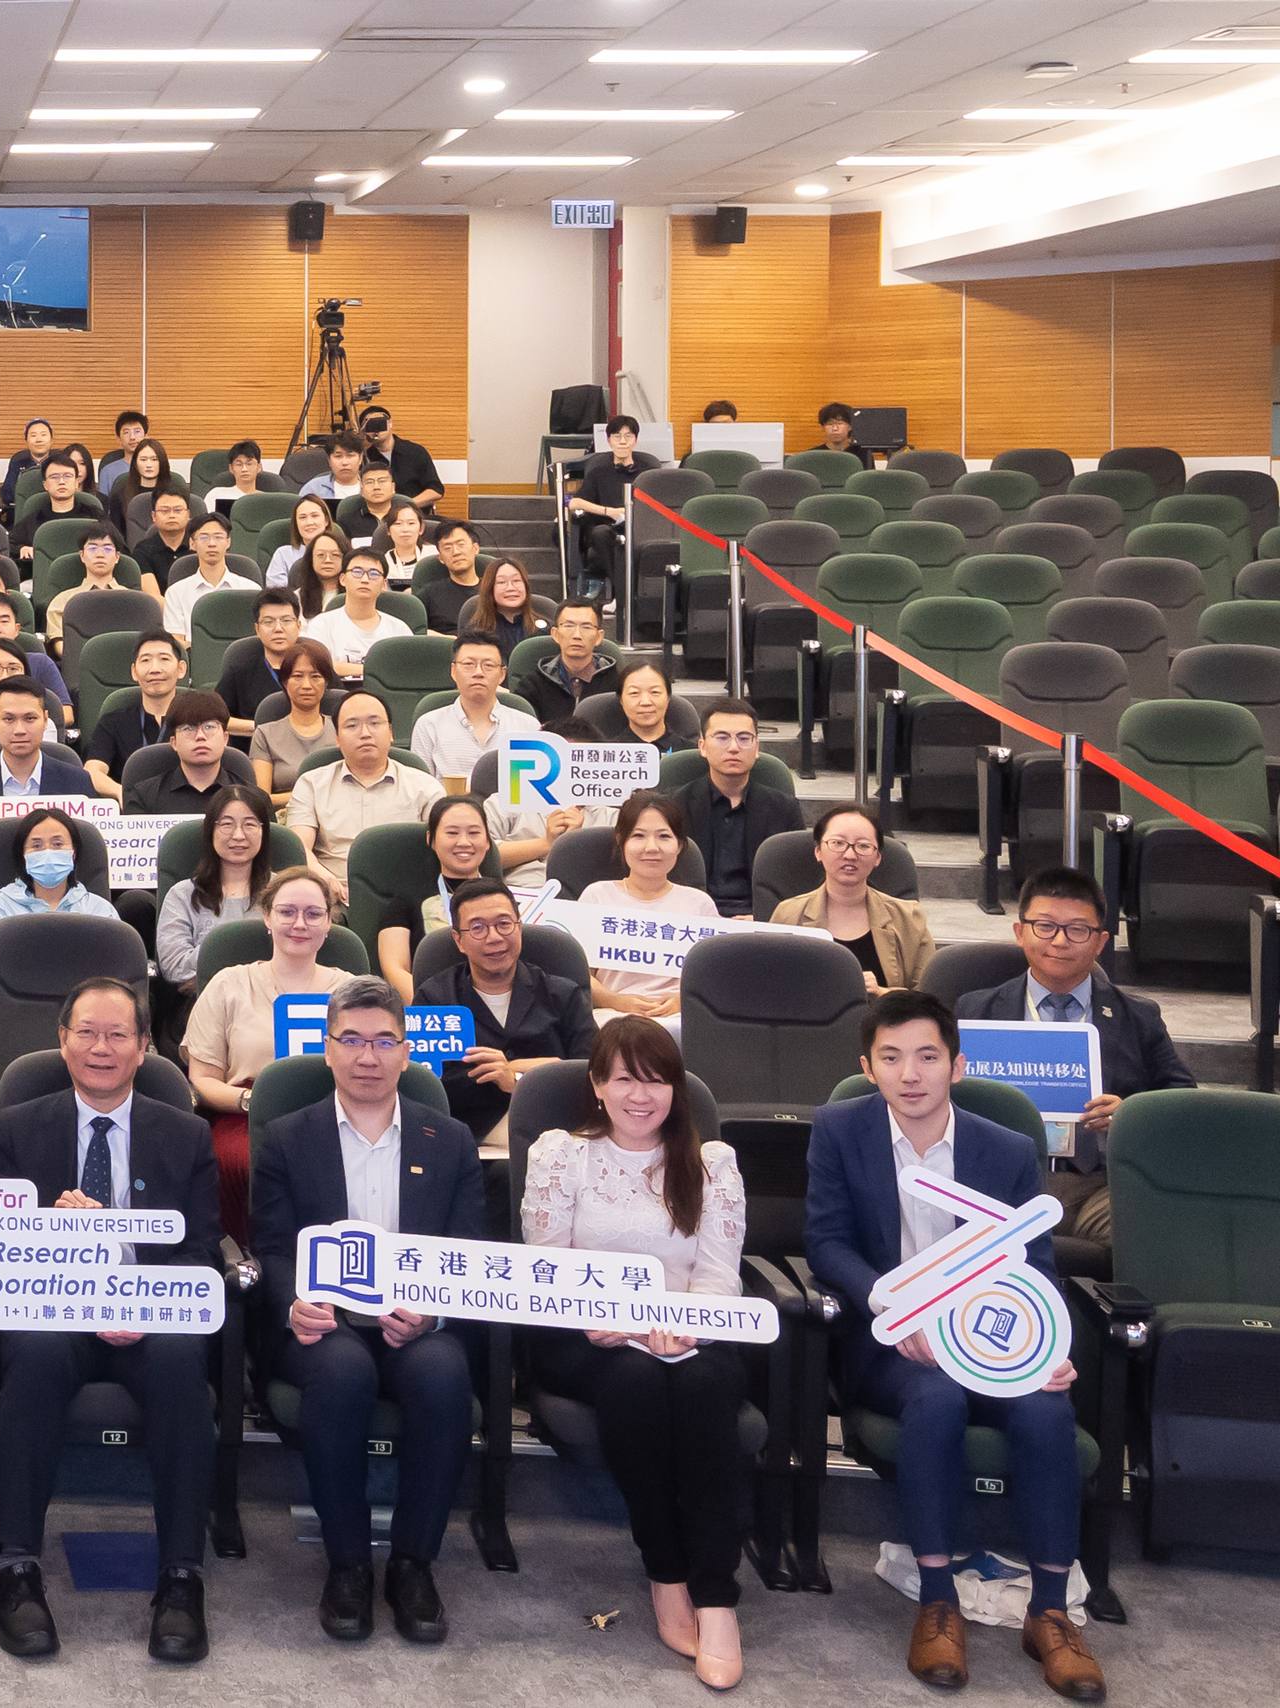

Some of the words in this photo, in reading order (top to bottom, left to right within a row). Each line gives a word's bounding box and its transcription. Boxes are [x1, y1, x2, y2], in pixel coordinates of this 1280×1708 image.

[555, 205, 586, 224] EXIT
[587, 205, 611, 224] 出口
[571, 750, 648, 763] 研發辦公室
[571, 766, 648, 780] Research
[571, 783, 621, 797] Office
[92, 805, 113, 816] for
[599, 946, 656, 965] HKBU
[50, 1217, 174, 1234] UNIVERSITIES
[393, 1247, 652, 1292] 香港浸會大學
[105, 1274, 210, 1298] Scheme
[392, 1282, 451, 1305] HONG
[461, 1287, 519, 1311] KONG
[529, 1295, 620, 1320] BAPTIST
[630, 1303, 762, 1330] UNIVERSITY
[110, 1433, 121, 1442] 12
[375, 1443, 386, 1452] 13
